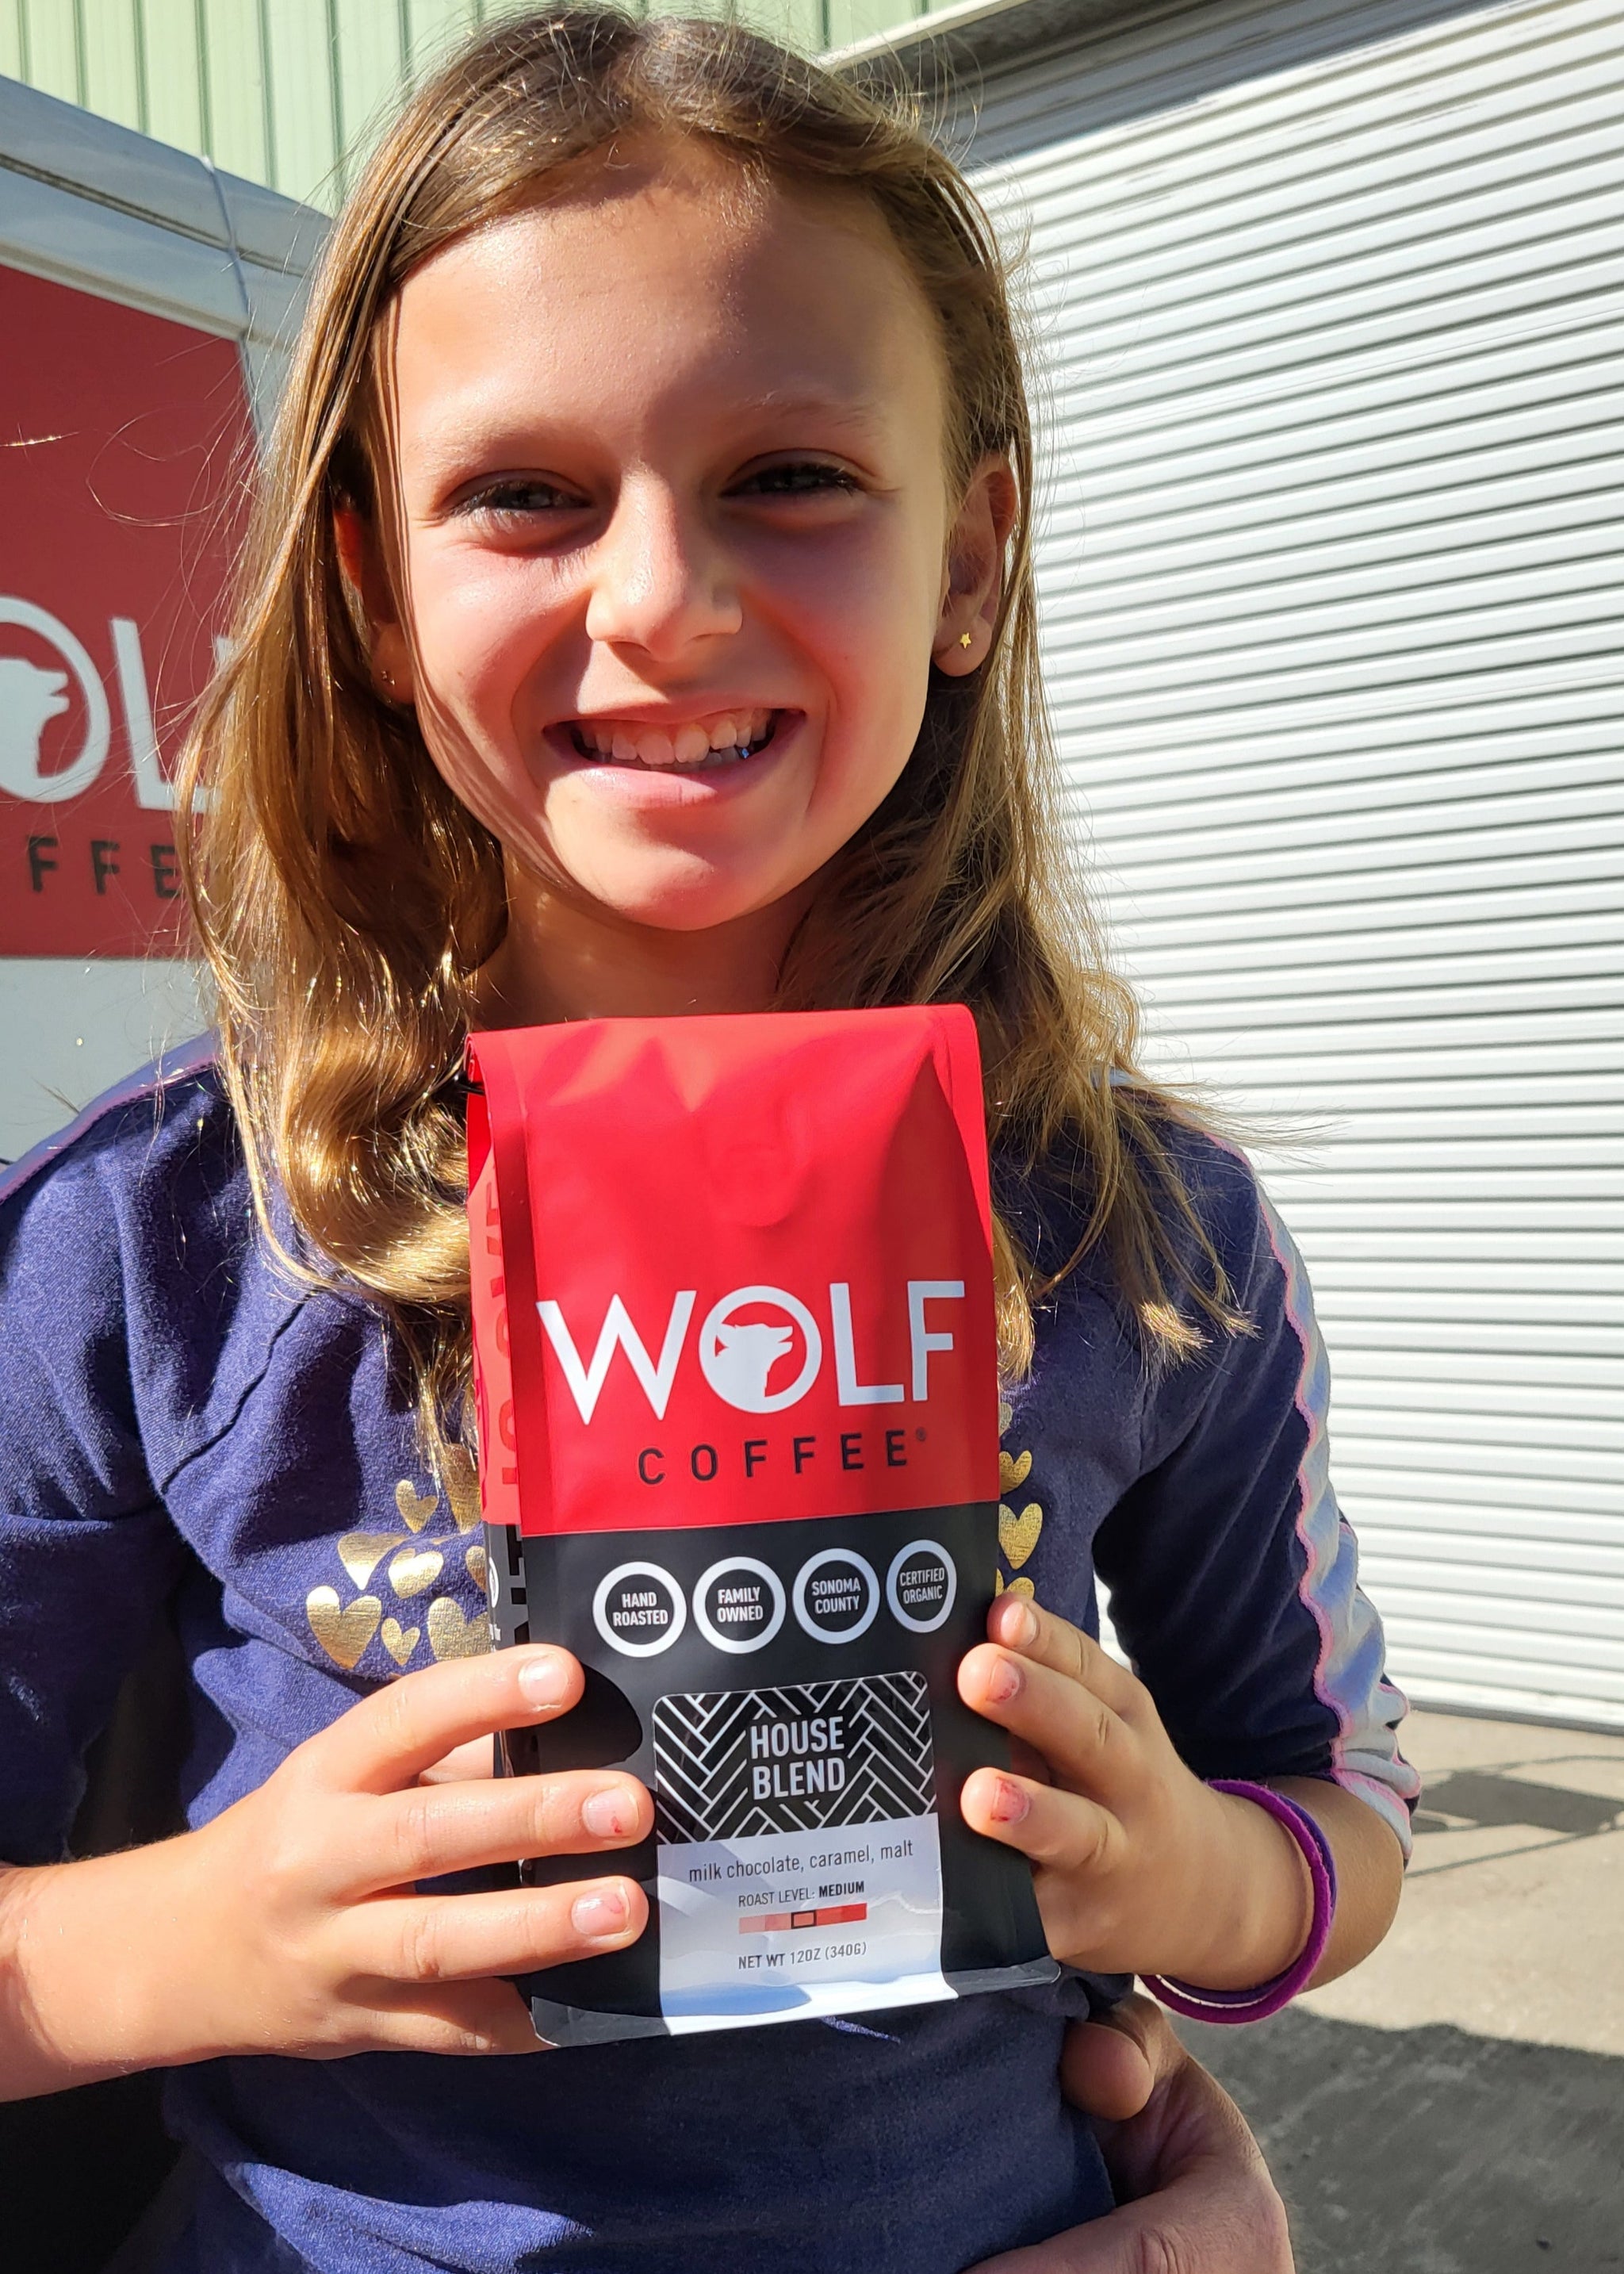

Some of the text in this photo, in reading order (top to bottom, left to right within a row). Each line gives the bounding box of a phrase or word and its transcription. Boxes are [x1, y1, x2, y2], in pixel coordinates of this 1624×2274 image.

[535, 1280, 964, 1425] WOLF
[899, 1567, 945, 1586] CERTIFIED
[717, 1586, 761, 1604] FAMILY
[811, 1577, 861, 1597] SONOMA
[902, 1586, 943, 1605] ORGANIC
[621, 1591, 657, 1608] HAND
[814, 1595, 860, 1614] COUNTY
[612, 1609, 668, 1627] ROASTED
[717, 1605, 764, 1623] OWNED
[750, 1716, 845, 1759] HOUSE
[753, 1757, 845, 1800] BLEND
[689, 1839, 914, 1883] milk chocolate, caramel, malt
[738, 1881, 865, 1908] ROAST LEVEL: MEDIUM
[738, 1954, 763, 1969] NET
[766, 1953, 786, 1967] WT
[825, 1942, 867, 1961] (340G)
